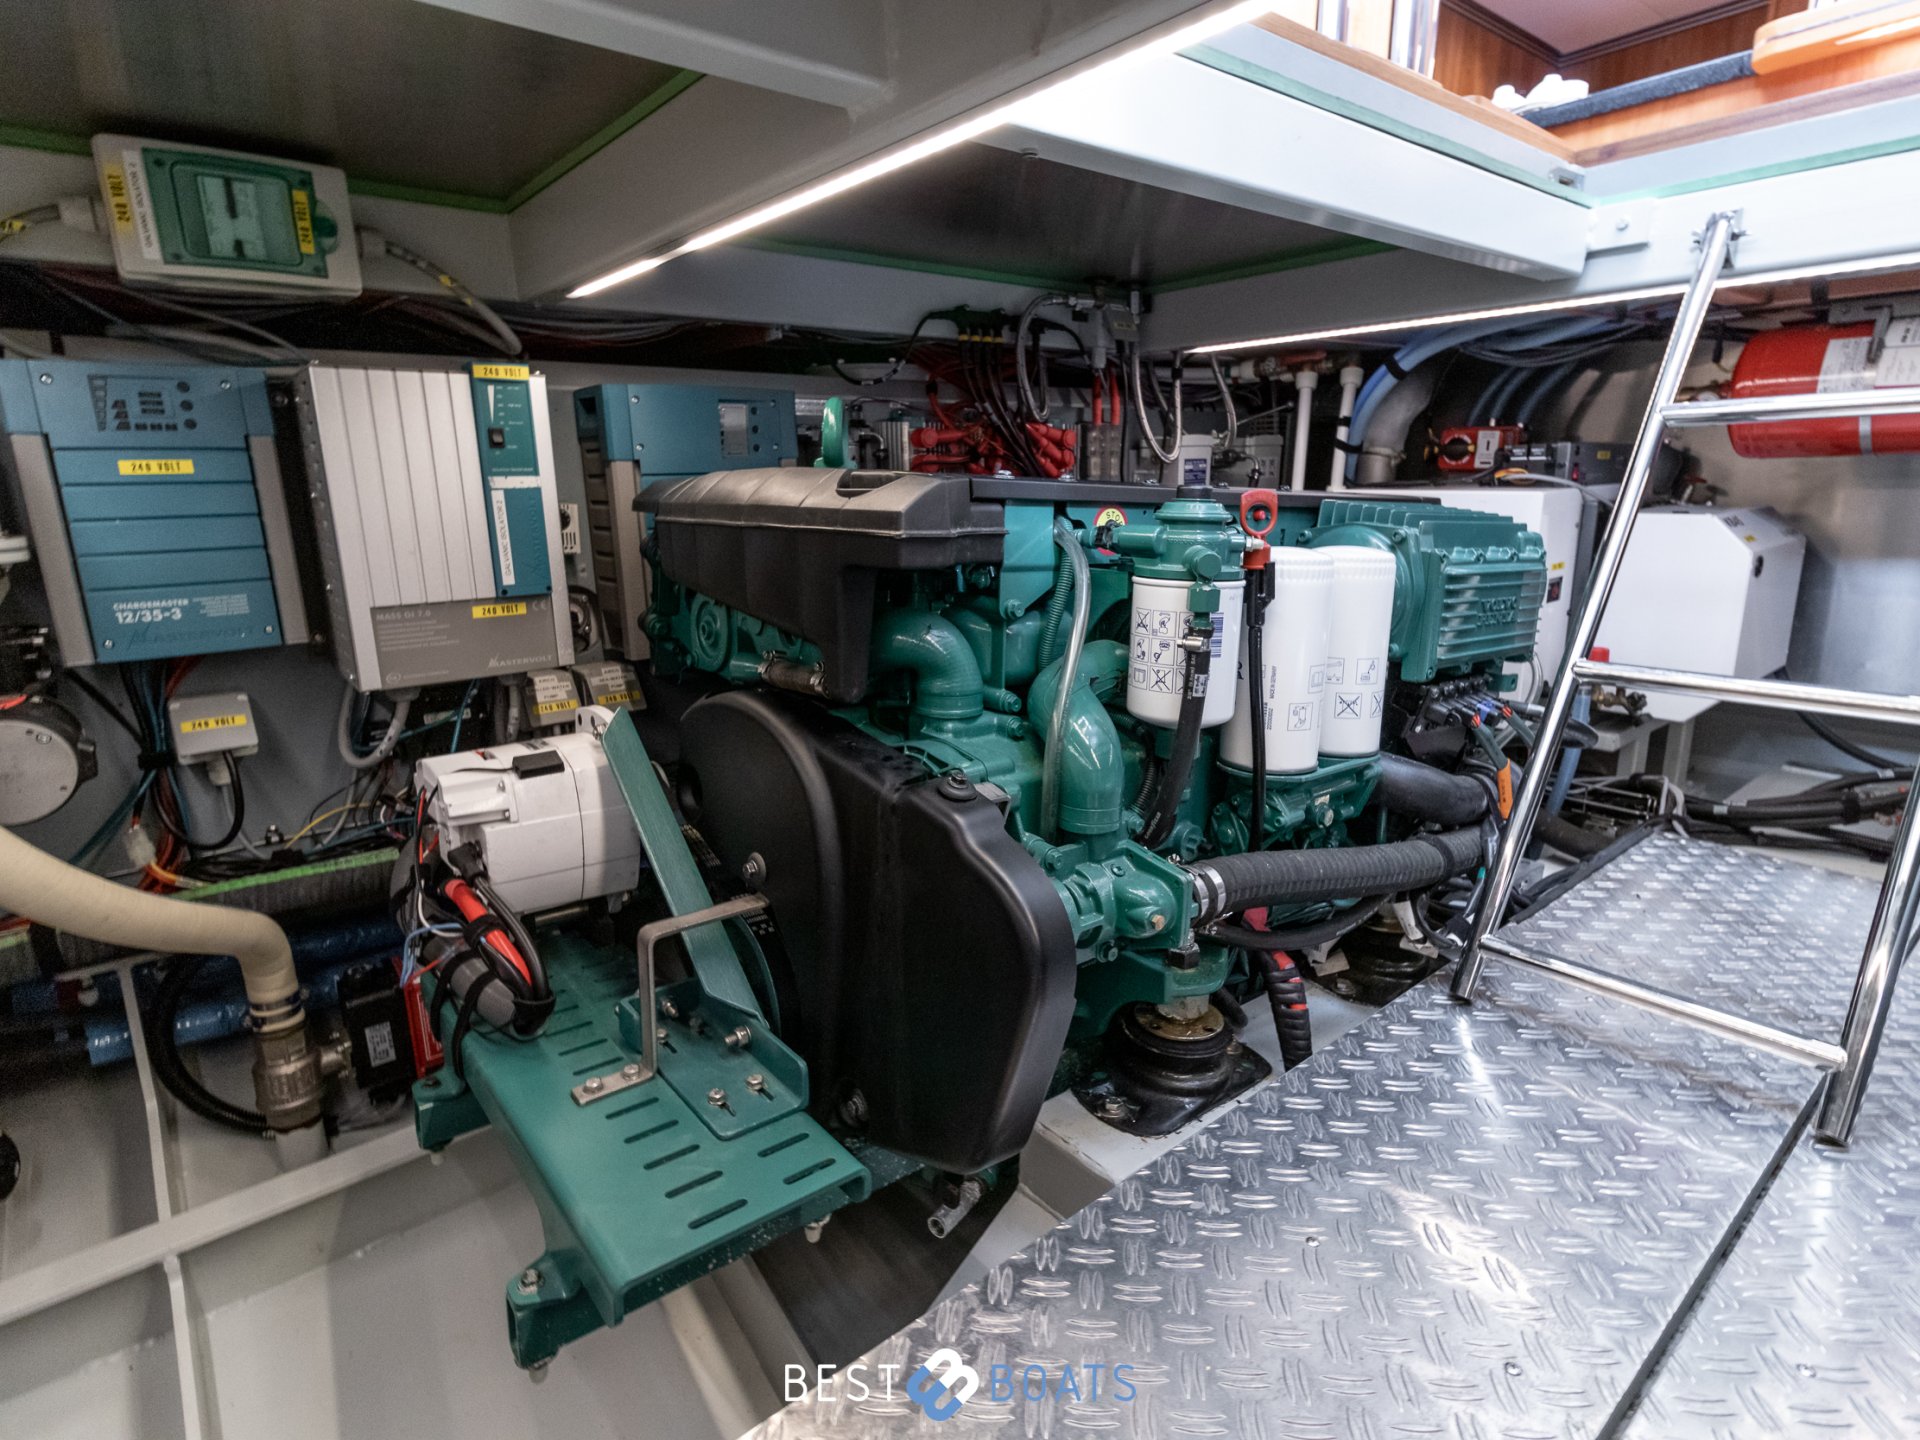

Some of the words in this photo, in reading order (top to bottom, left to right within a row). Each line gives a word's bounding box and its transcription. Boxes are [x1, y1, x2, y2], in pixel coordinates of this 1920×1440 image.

[484, 366, 501, 377] 240
[504, 367, 522, 378] VOLT
[130, 462, 152, 472] 240
[157, 461, 181, 472] VOLT
[113, 597, 190, 612] CHARGEMASTER
[482, 606, 497, 616] 240
[501, 603, 520, 614] VOLT
[115, 606, 183, 625] 12/35-3
[376, 611, 402, 621] MASS
[418, 608, 432, 618] 7.0
[487, 654, 553, 669] MASTERVOLT
[556, 700, 572, 710] VOLT
[191, 720, 210, 731] 240
[214, 715, 236, 727] VOLT
